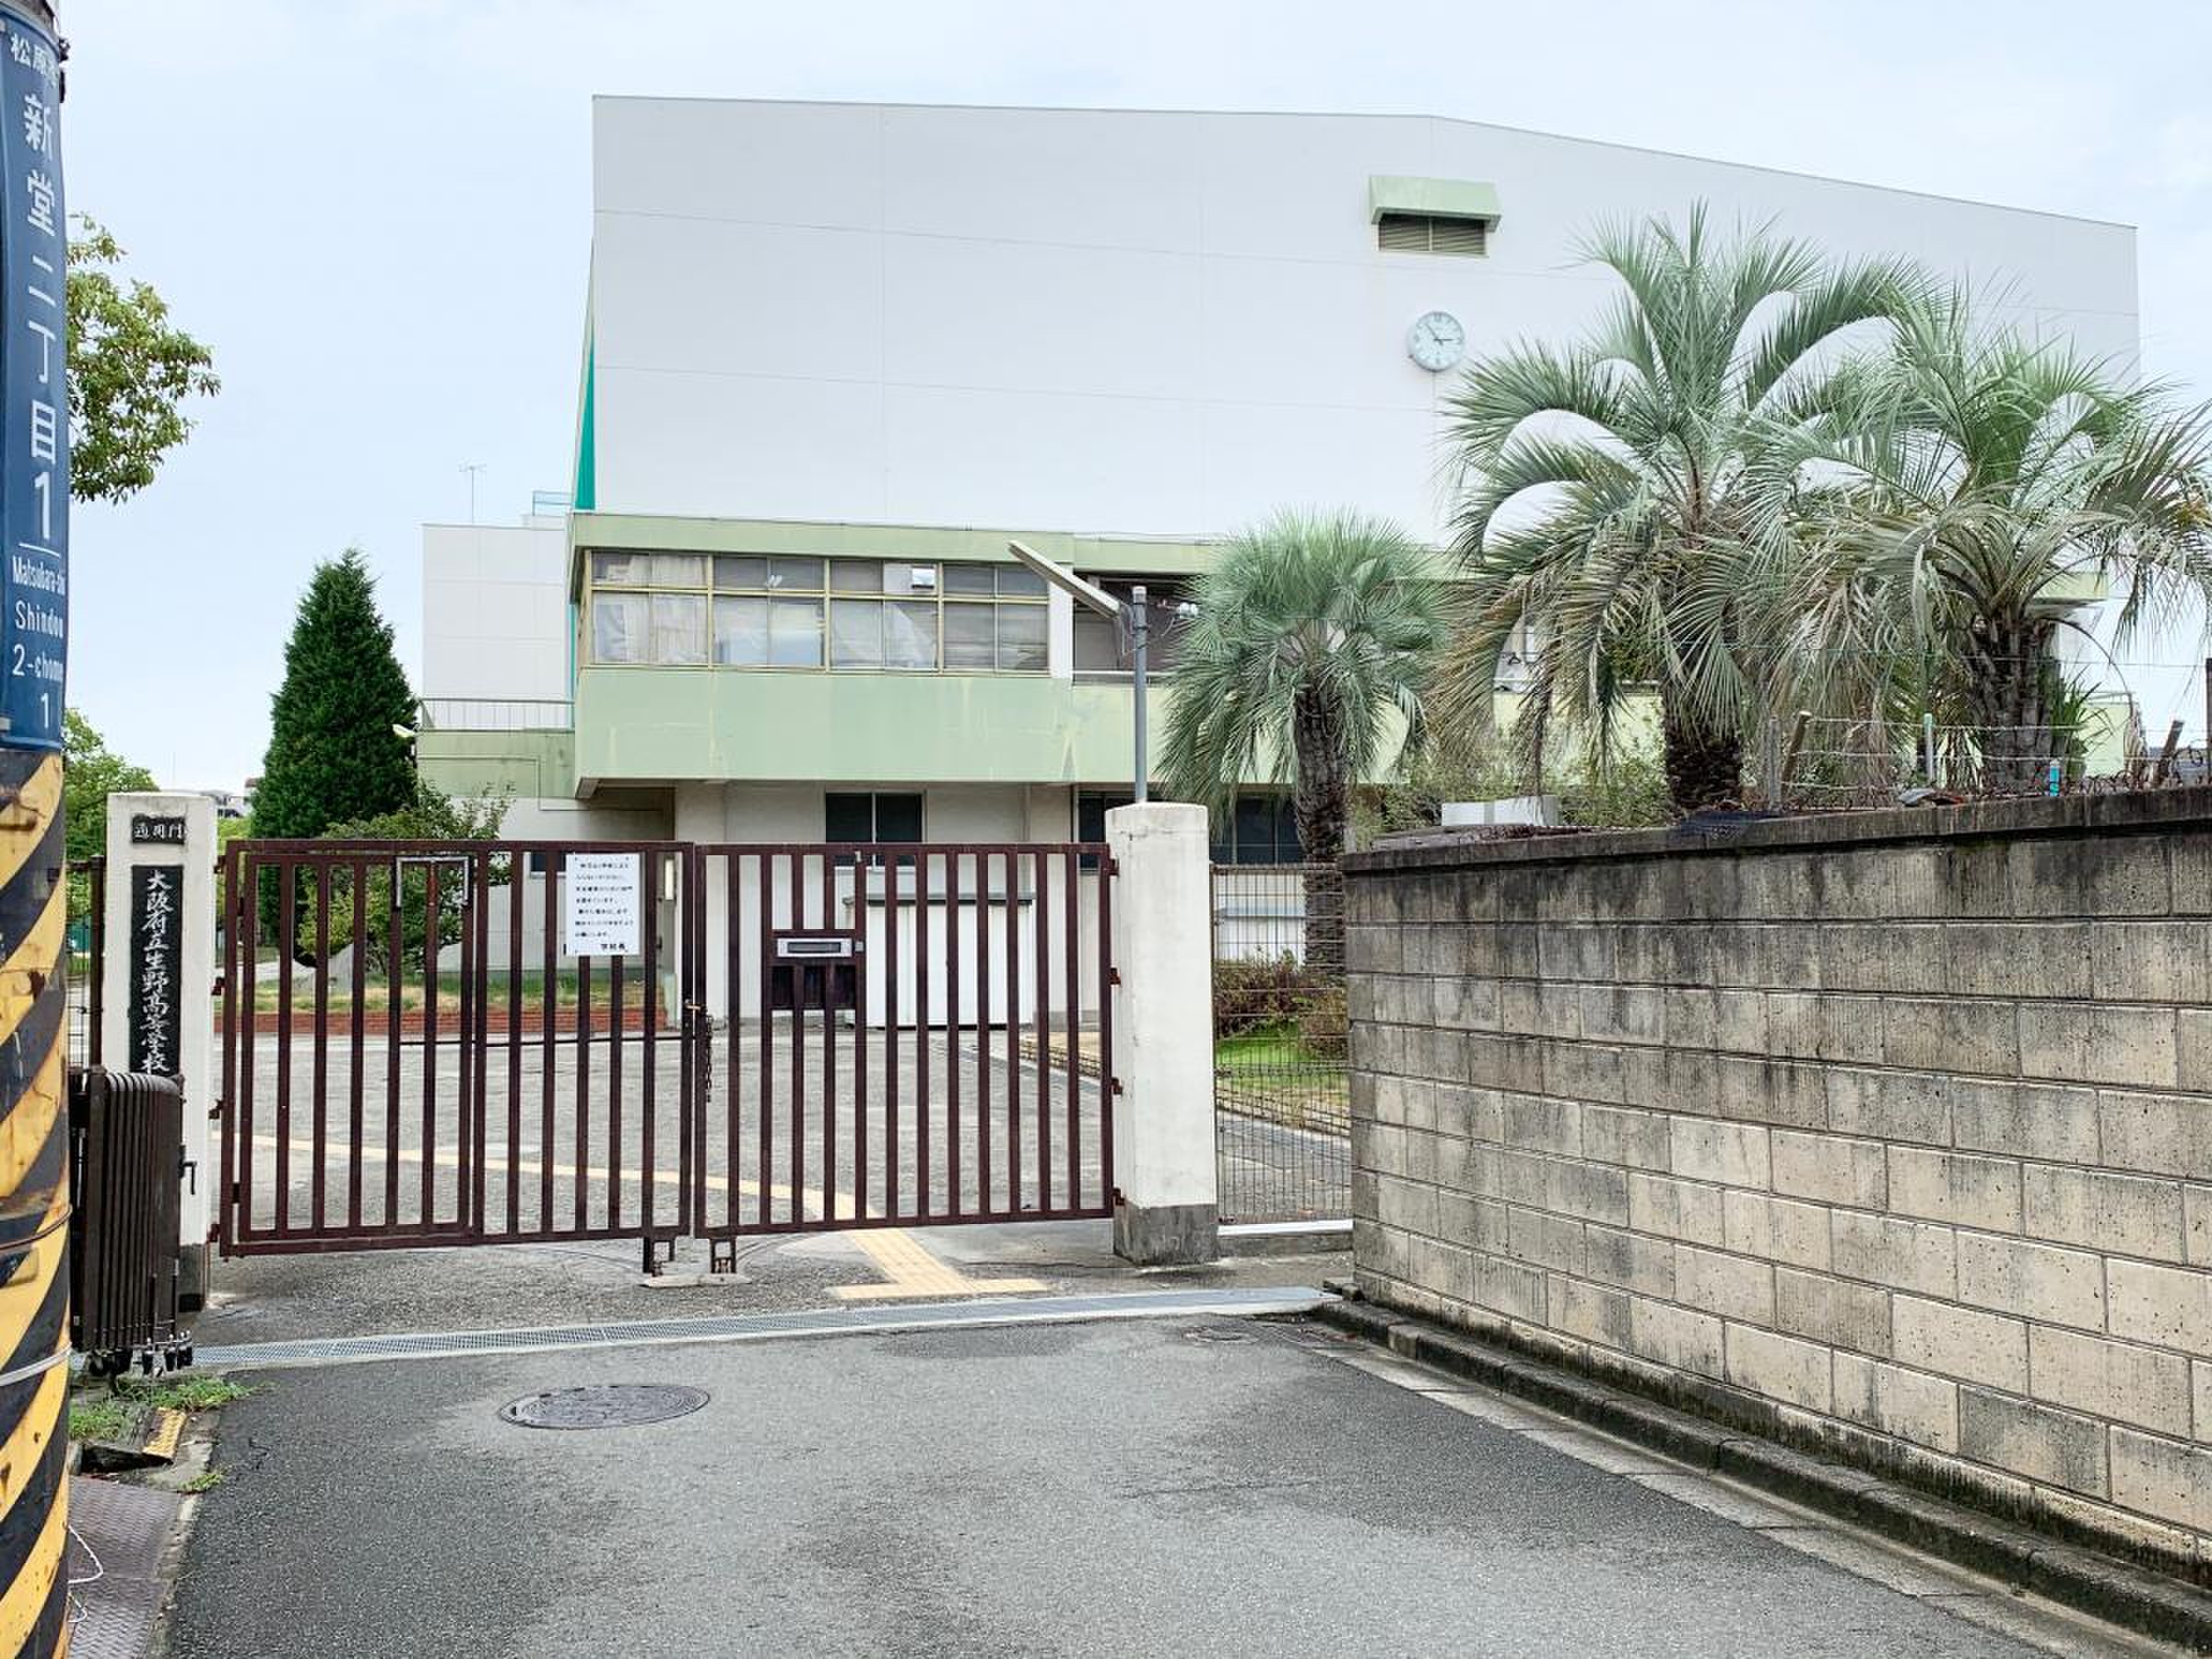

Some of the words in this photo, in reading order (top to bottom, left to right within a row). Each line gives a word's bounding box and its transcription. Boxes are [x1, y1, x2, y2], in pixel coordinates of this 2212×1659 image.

[41, 692, 50, 729] 1
[140, 869, 173, 1075] 大阪府立生野高等学校
